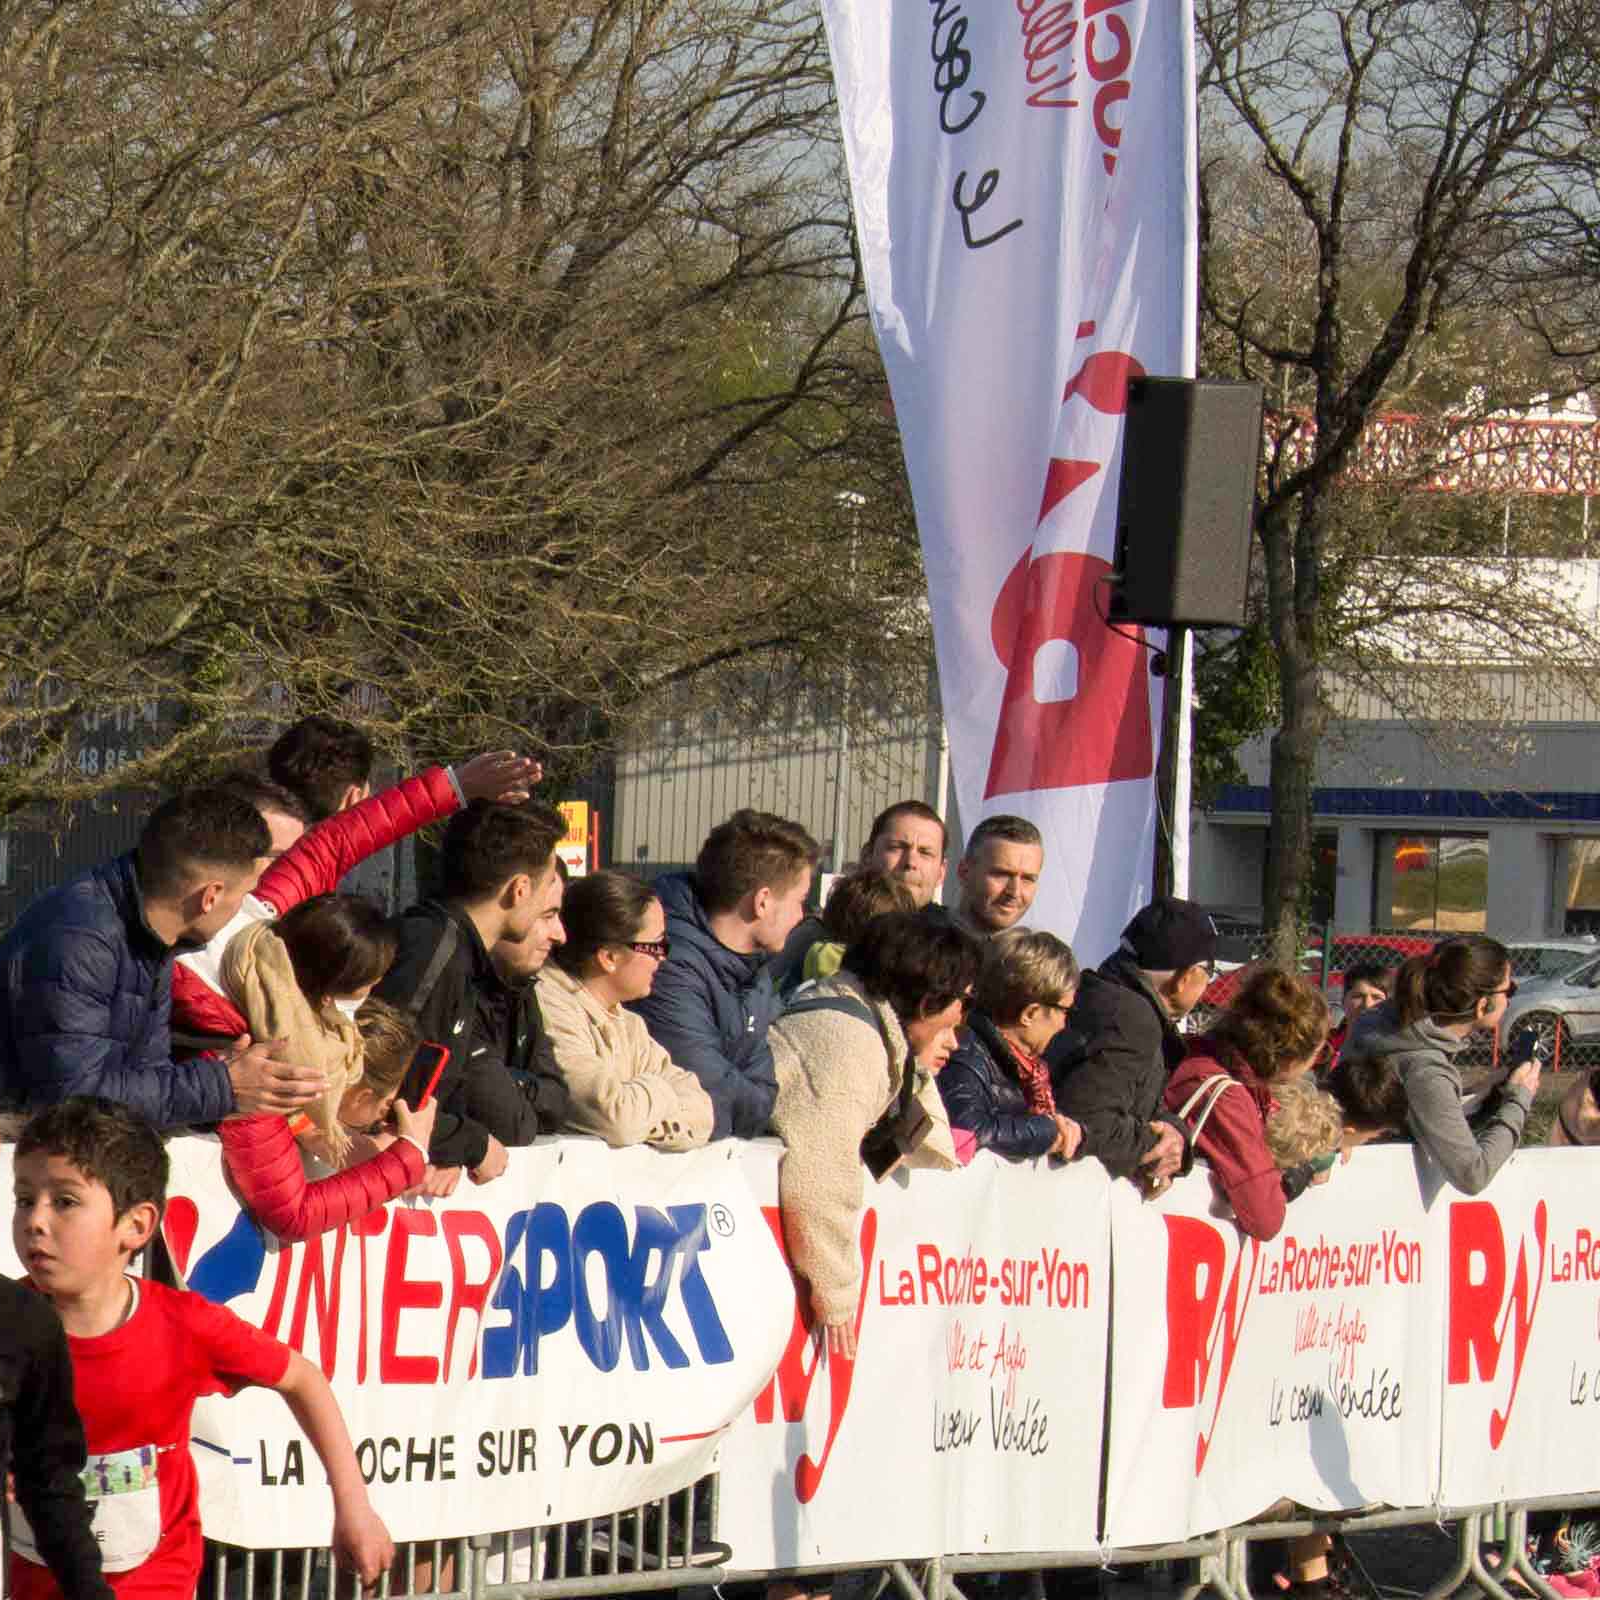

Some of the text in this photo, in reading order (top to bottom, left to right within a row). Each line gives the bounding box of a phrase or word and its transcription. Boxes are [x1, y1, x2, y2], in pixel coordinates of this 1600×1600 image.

[261, 1200, 735, 1386] INTERSPORT
[1269, 1376, 1284, 1427] Le
[1569, 1360, 1587, 1406] Le
[260, 1422, 655, 1486] LA OCHE SUR YON
